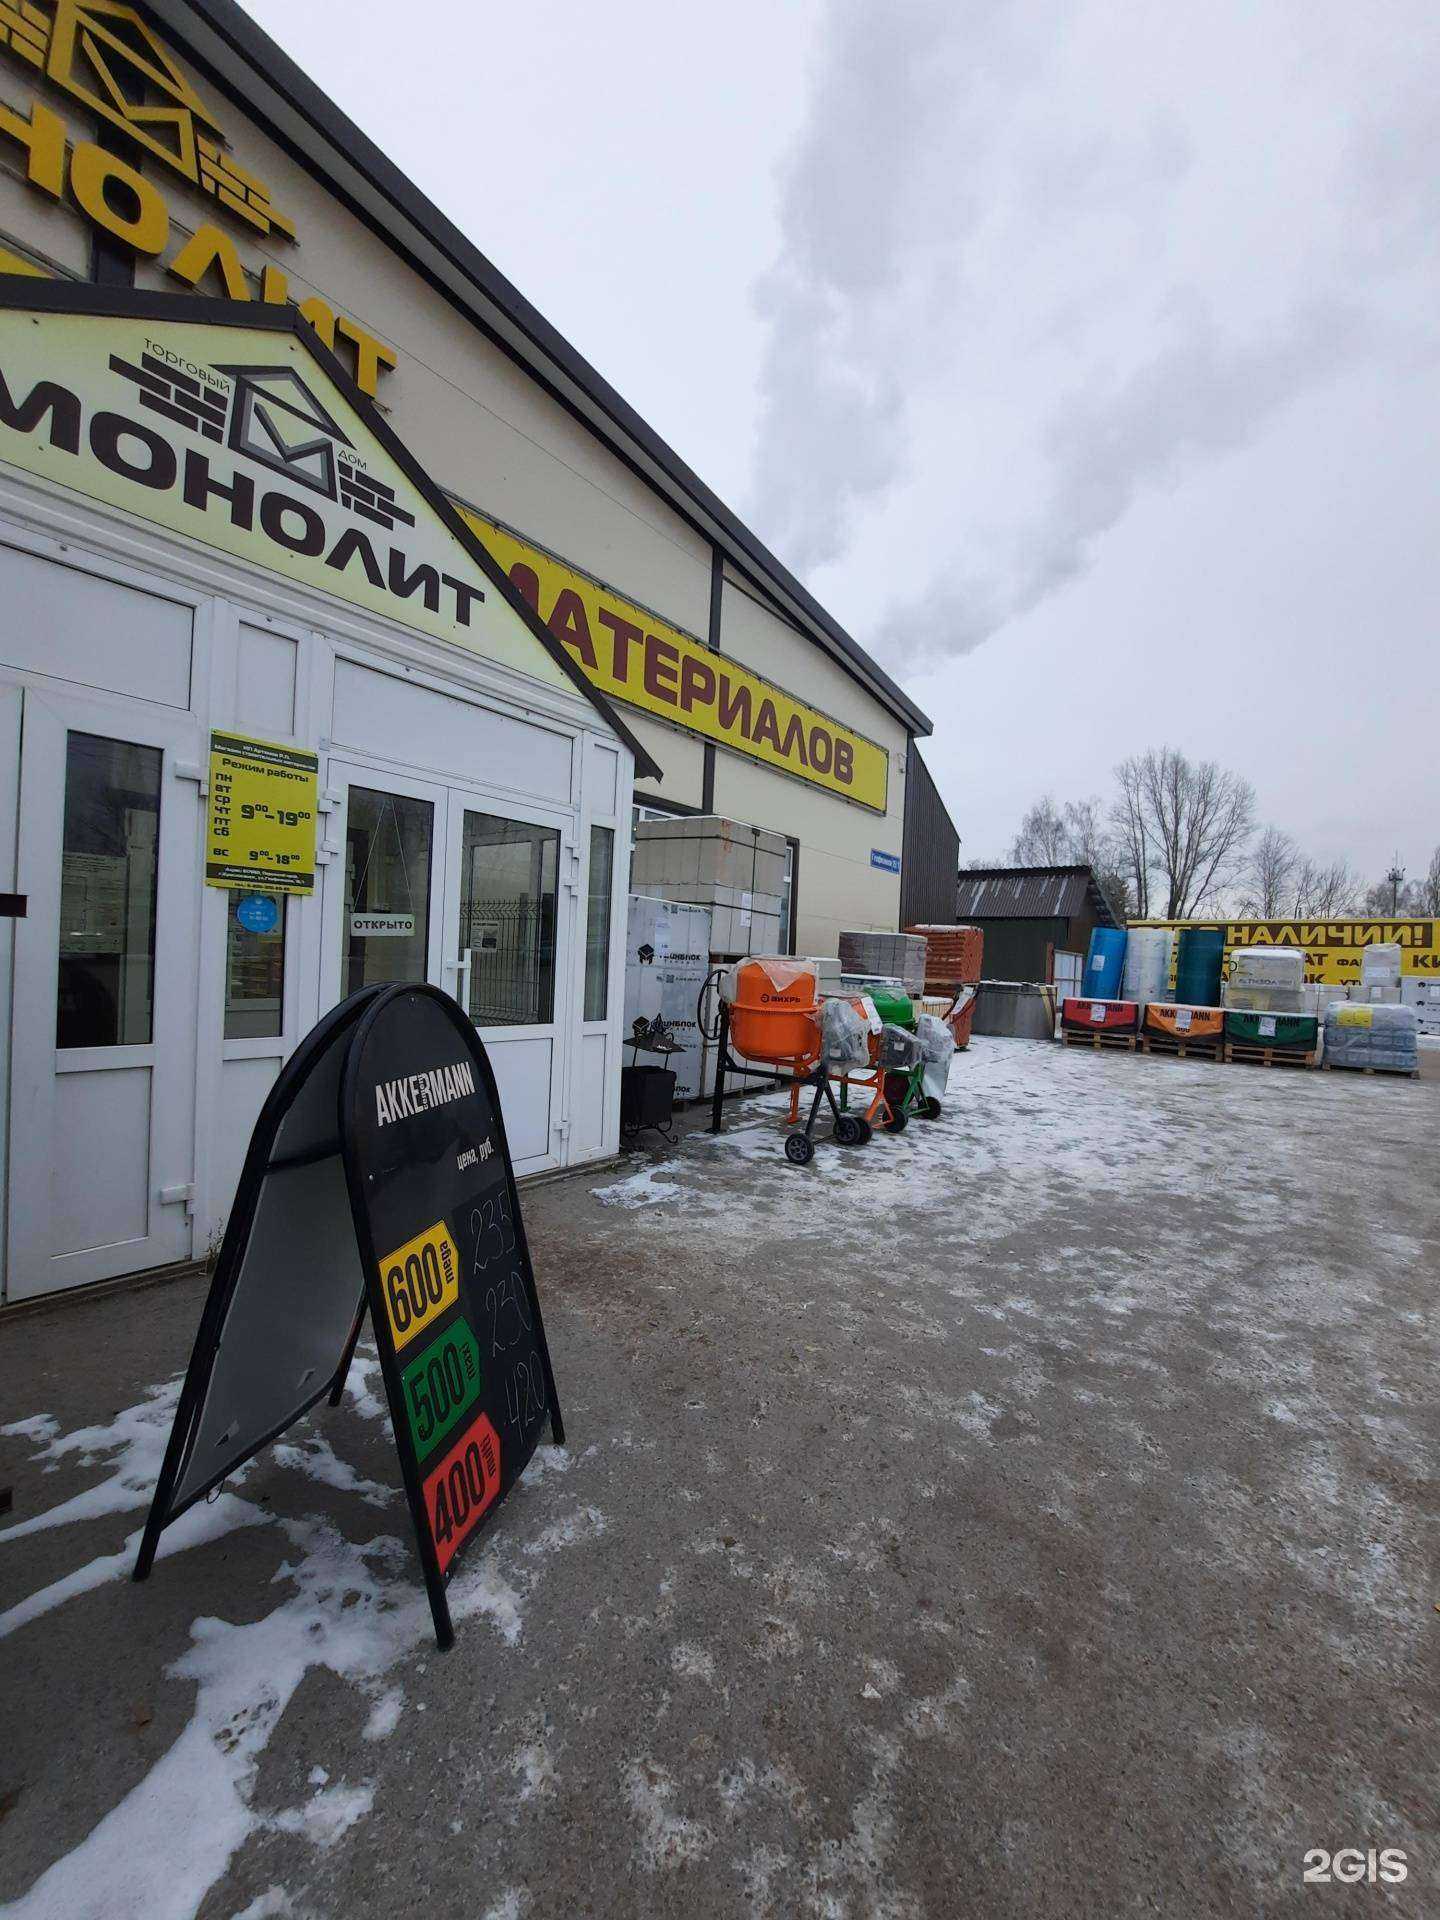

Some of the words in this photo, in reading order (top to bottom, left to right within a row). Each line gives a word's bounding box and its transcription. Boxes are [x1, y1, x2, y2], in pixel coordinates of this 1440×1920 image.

[222, 757, 265, 774] Режим
[267, 768, 309, 783] работы
[1227, 925, 1423, 946] НАЛИЧИИ!
[1160, 1008, 1211, 1021] AKKANN
[375, 1061, 476, 1127] AKKERMANN
[456, 1147, 479, 1172] цена,
[478, 1136, 495, 1162] руб.
[387, 1242, 443, 1333] 600
[439, 1240, 455, 1285] mega
[409, 1342, 465, 1442] 500
[504, 1351, 545, 1445] 420
[435, 1442, 486, 1545] 400
